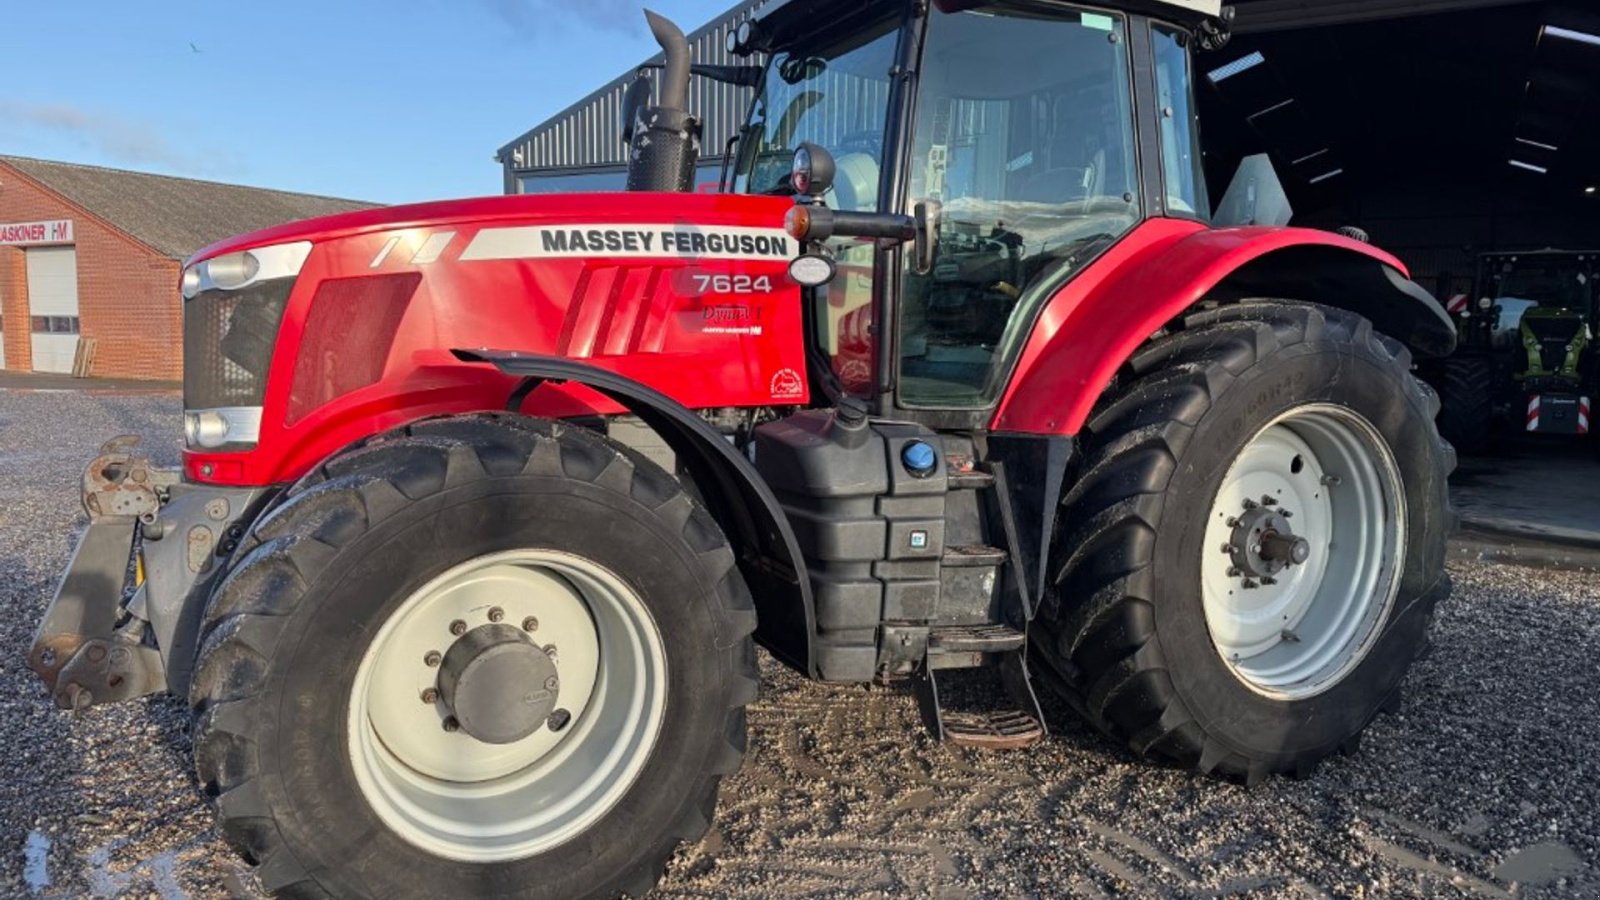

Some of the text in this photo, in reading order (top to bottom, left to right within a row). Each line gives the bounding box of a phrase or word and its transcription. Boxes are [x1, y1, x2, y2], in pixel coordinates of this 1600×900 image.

[0, 224, 45, 242] ASKINER
[541, 230, 788, 256] MASSEY FERGUSON
[693, 275, 772, 293] 7624
